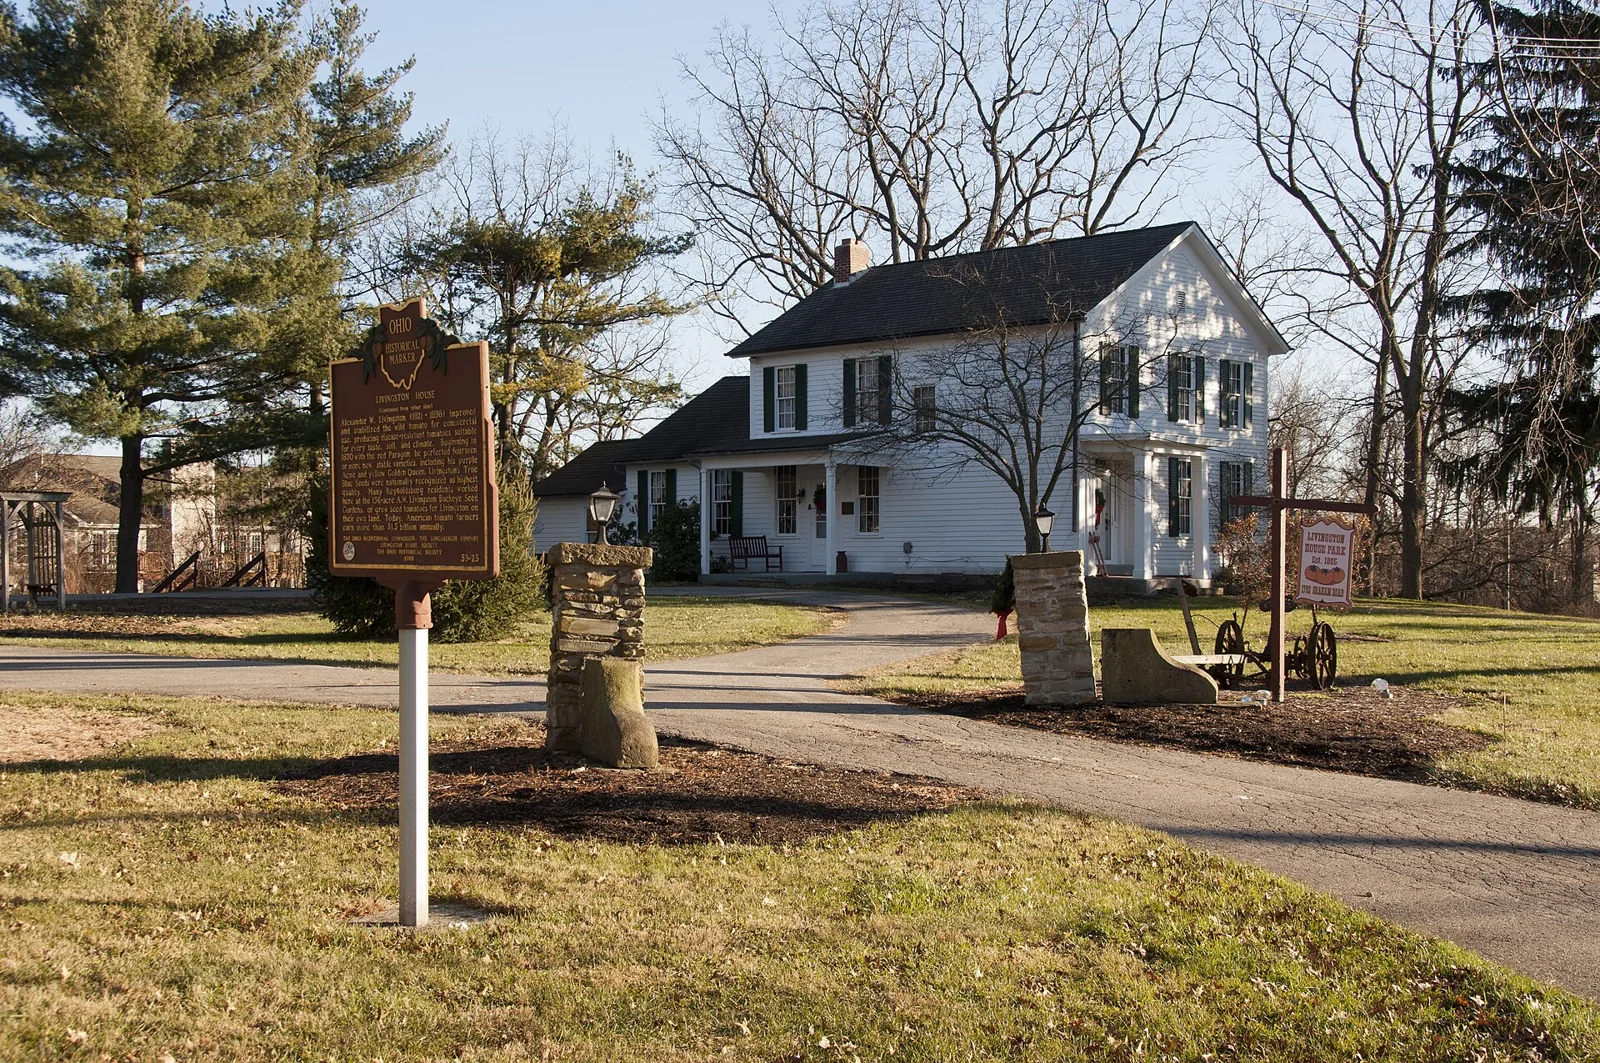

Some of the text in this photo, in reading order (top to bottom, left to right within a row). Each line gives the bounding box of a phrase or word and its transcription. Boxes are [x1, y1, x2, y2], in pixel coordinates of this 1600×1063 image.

[389, 317, 411, 334] OHIO
[386, 340, 420, 354] HISTORICAL
[389, 353, 415, 364] MARKER
[376, 390, 435, 403] LIVINGSTON HOUSE
[341, 418, 366, 426] Alexander
[379, 415, 406, 424] Livingston
[449, 408, 476, 418] improved
[354, 425, 380, 433] stabilized
[431, 420, 439, 428] for
[444, 418, 477, 426] commercial
[354, 435, 379, 443] producing
[427, 429, 451, 437] tomatoes
[455, 427, 477, 435] suitable
[440, 438, 468, 448] Beginning
[424, 448, 450, 458] perfected
[459, 456, 478, 465] purple
[369, 470, 385, 478] yellow
[464, 466, 478, 474] True
[386, 478, 413, 486] nationally
[415, 477, 446, 485] recognized
[457, 476, 478, 484] highest
[386, 487, 423, 496] Reynoldsburg
[409, 496, 437, 505] Livingston
[439, 495, 462, 504] Buckeye
[375, 506, 389, 514] grew
[440, 504, 468, 514] Livingston
[420, 523, 444, 532] annually.
[1307, 532, 1345, 543] LIVINGSTON
[1305, 544, 1346, 555] HOUSE PARK
[461, 554, 479, 562] 59-25
[1312, 556, 1322, 564] Est.
